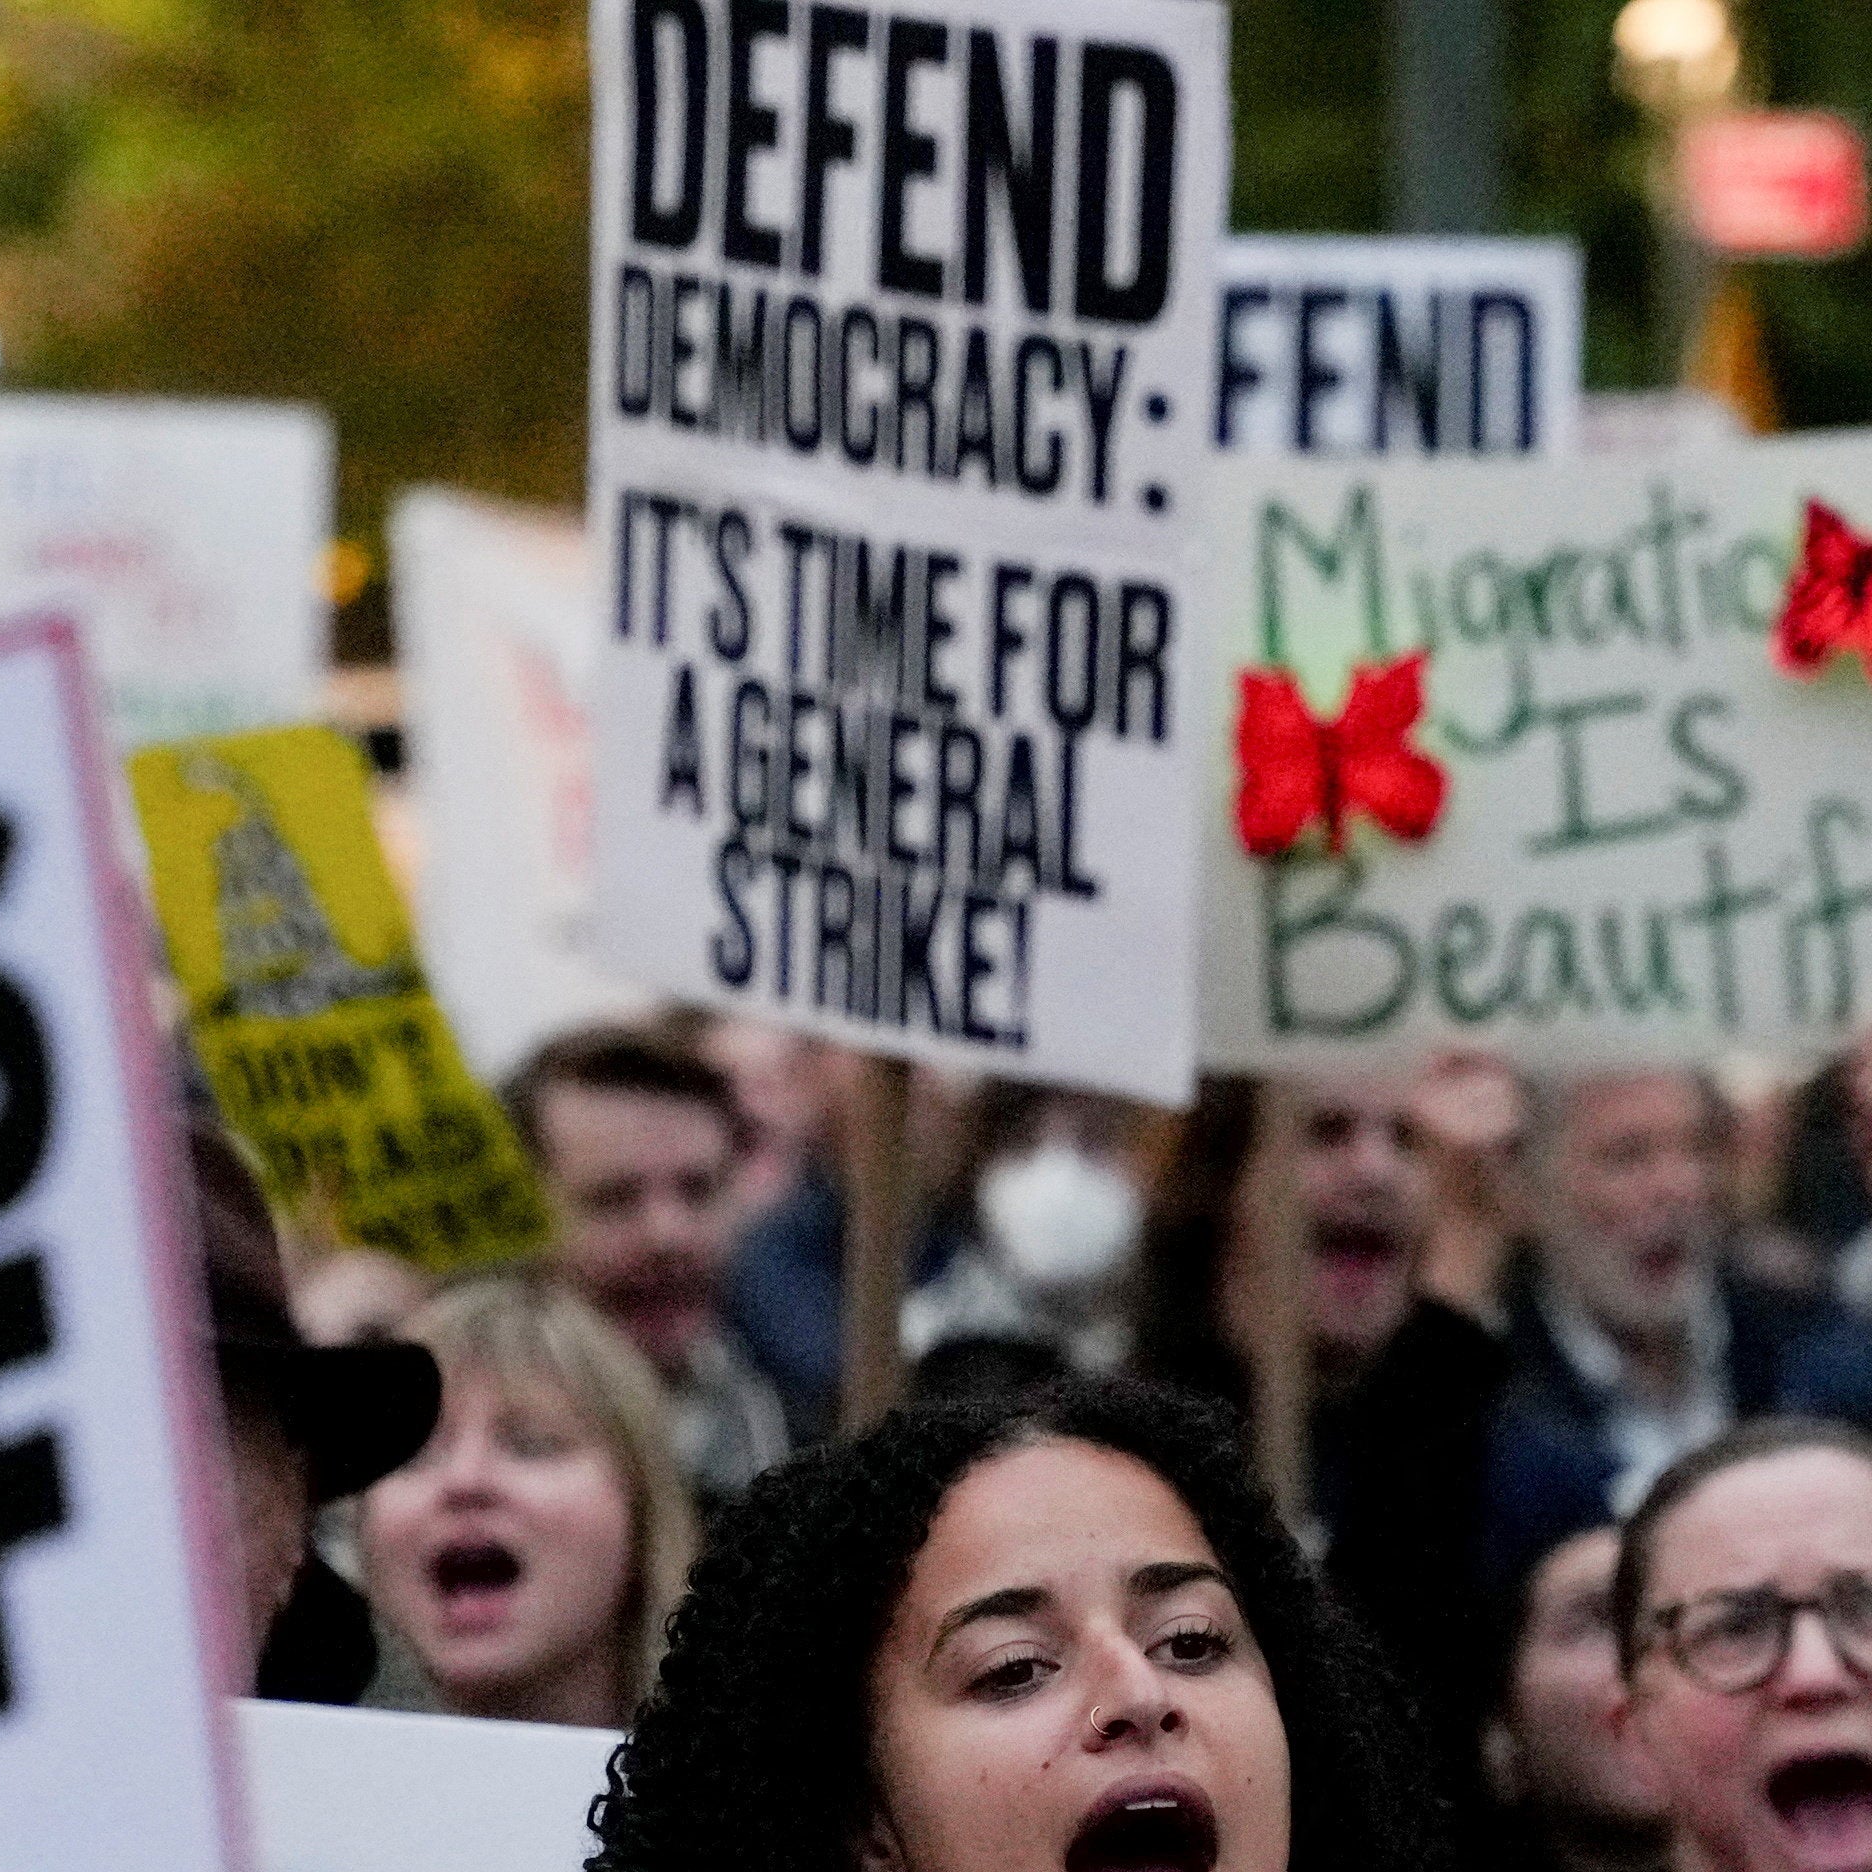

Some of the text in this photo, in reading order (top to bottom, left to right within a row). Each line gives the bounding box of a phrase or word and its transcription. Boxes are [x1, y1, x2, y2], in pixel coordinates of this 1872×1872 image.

[630, 0, 1178, 327] DEFEND
[618, 264, 1170, 513] DEMOCRACY:
[614, 490, 1173, 745] IT'S TIME FOR
[657, 659, 706, 819] A
[730, 678, 1098, 899] GENERAL
[708, 837, 1028, 1050] STRIKE!
